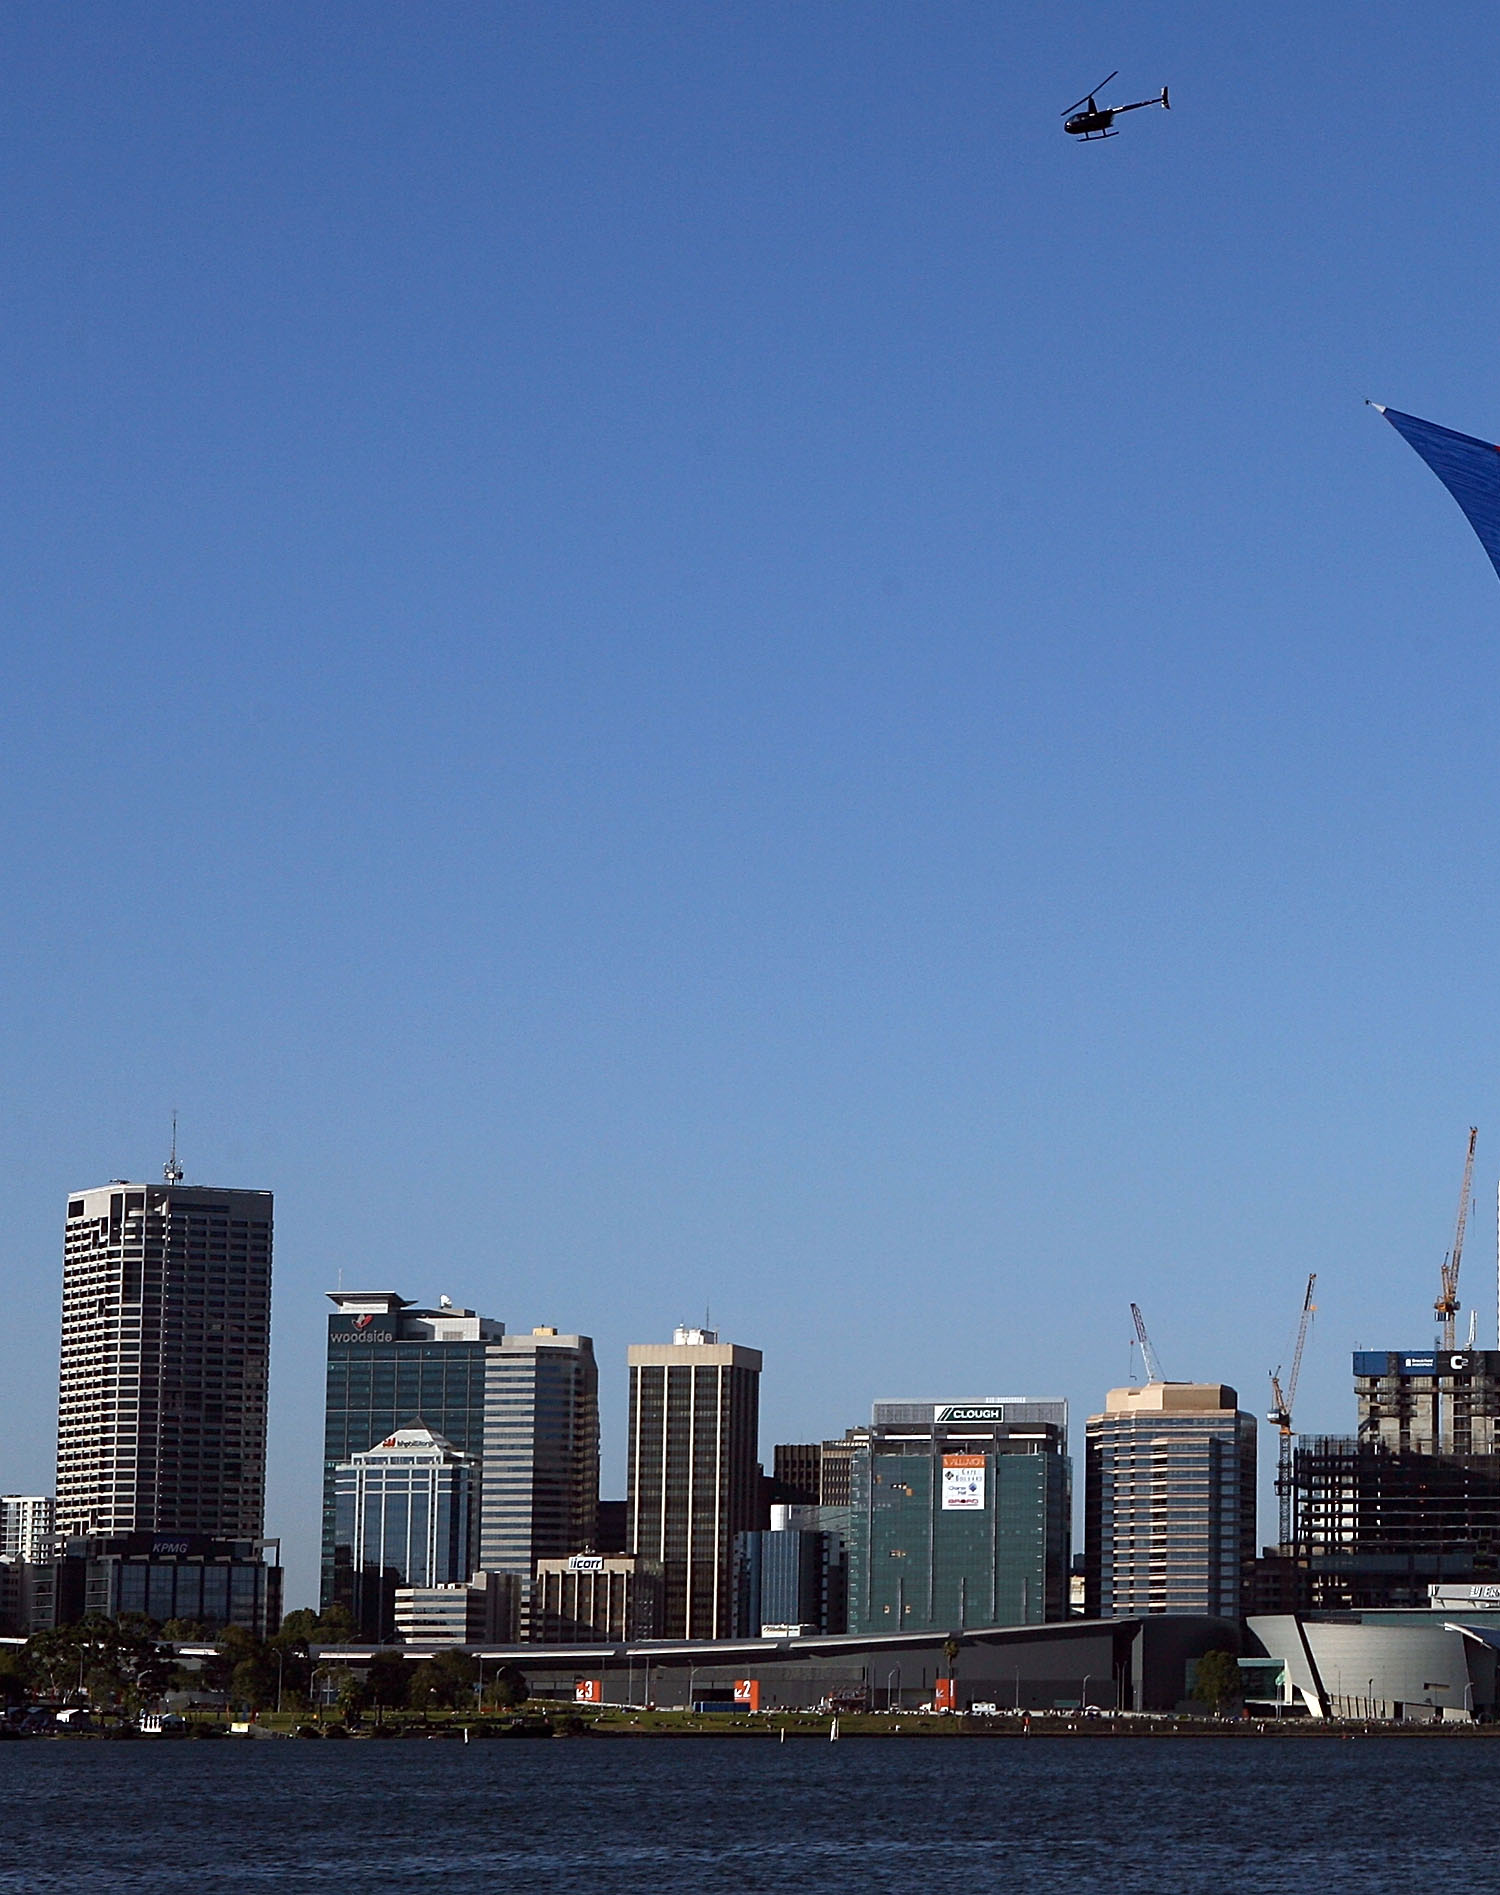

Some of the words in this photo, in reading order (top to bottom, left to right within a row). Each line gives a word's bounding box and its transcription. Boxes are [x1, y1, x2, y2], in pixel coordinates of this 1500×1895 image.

[330, 1330, 393, 1343] woodside
[953, 1409, 999, 1419] CLOUGH
[152, 1543, 188, 1553] KPMG
[584, 1680, 593, 1698] 3
[742, 1680, 751, 1698] 2
